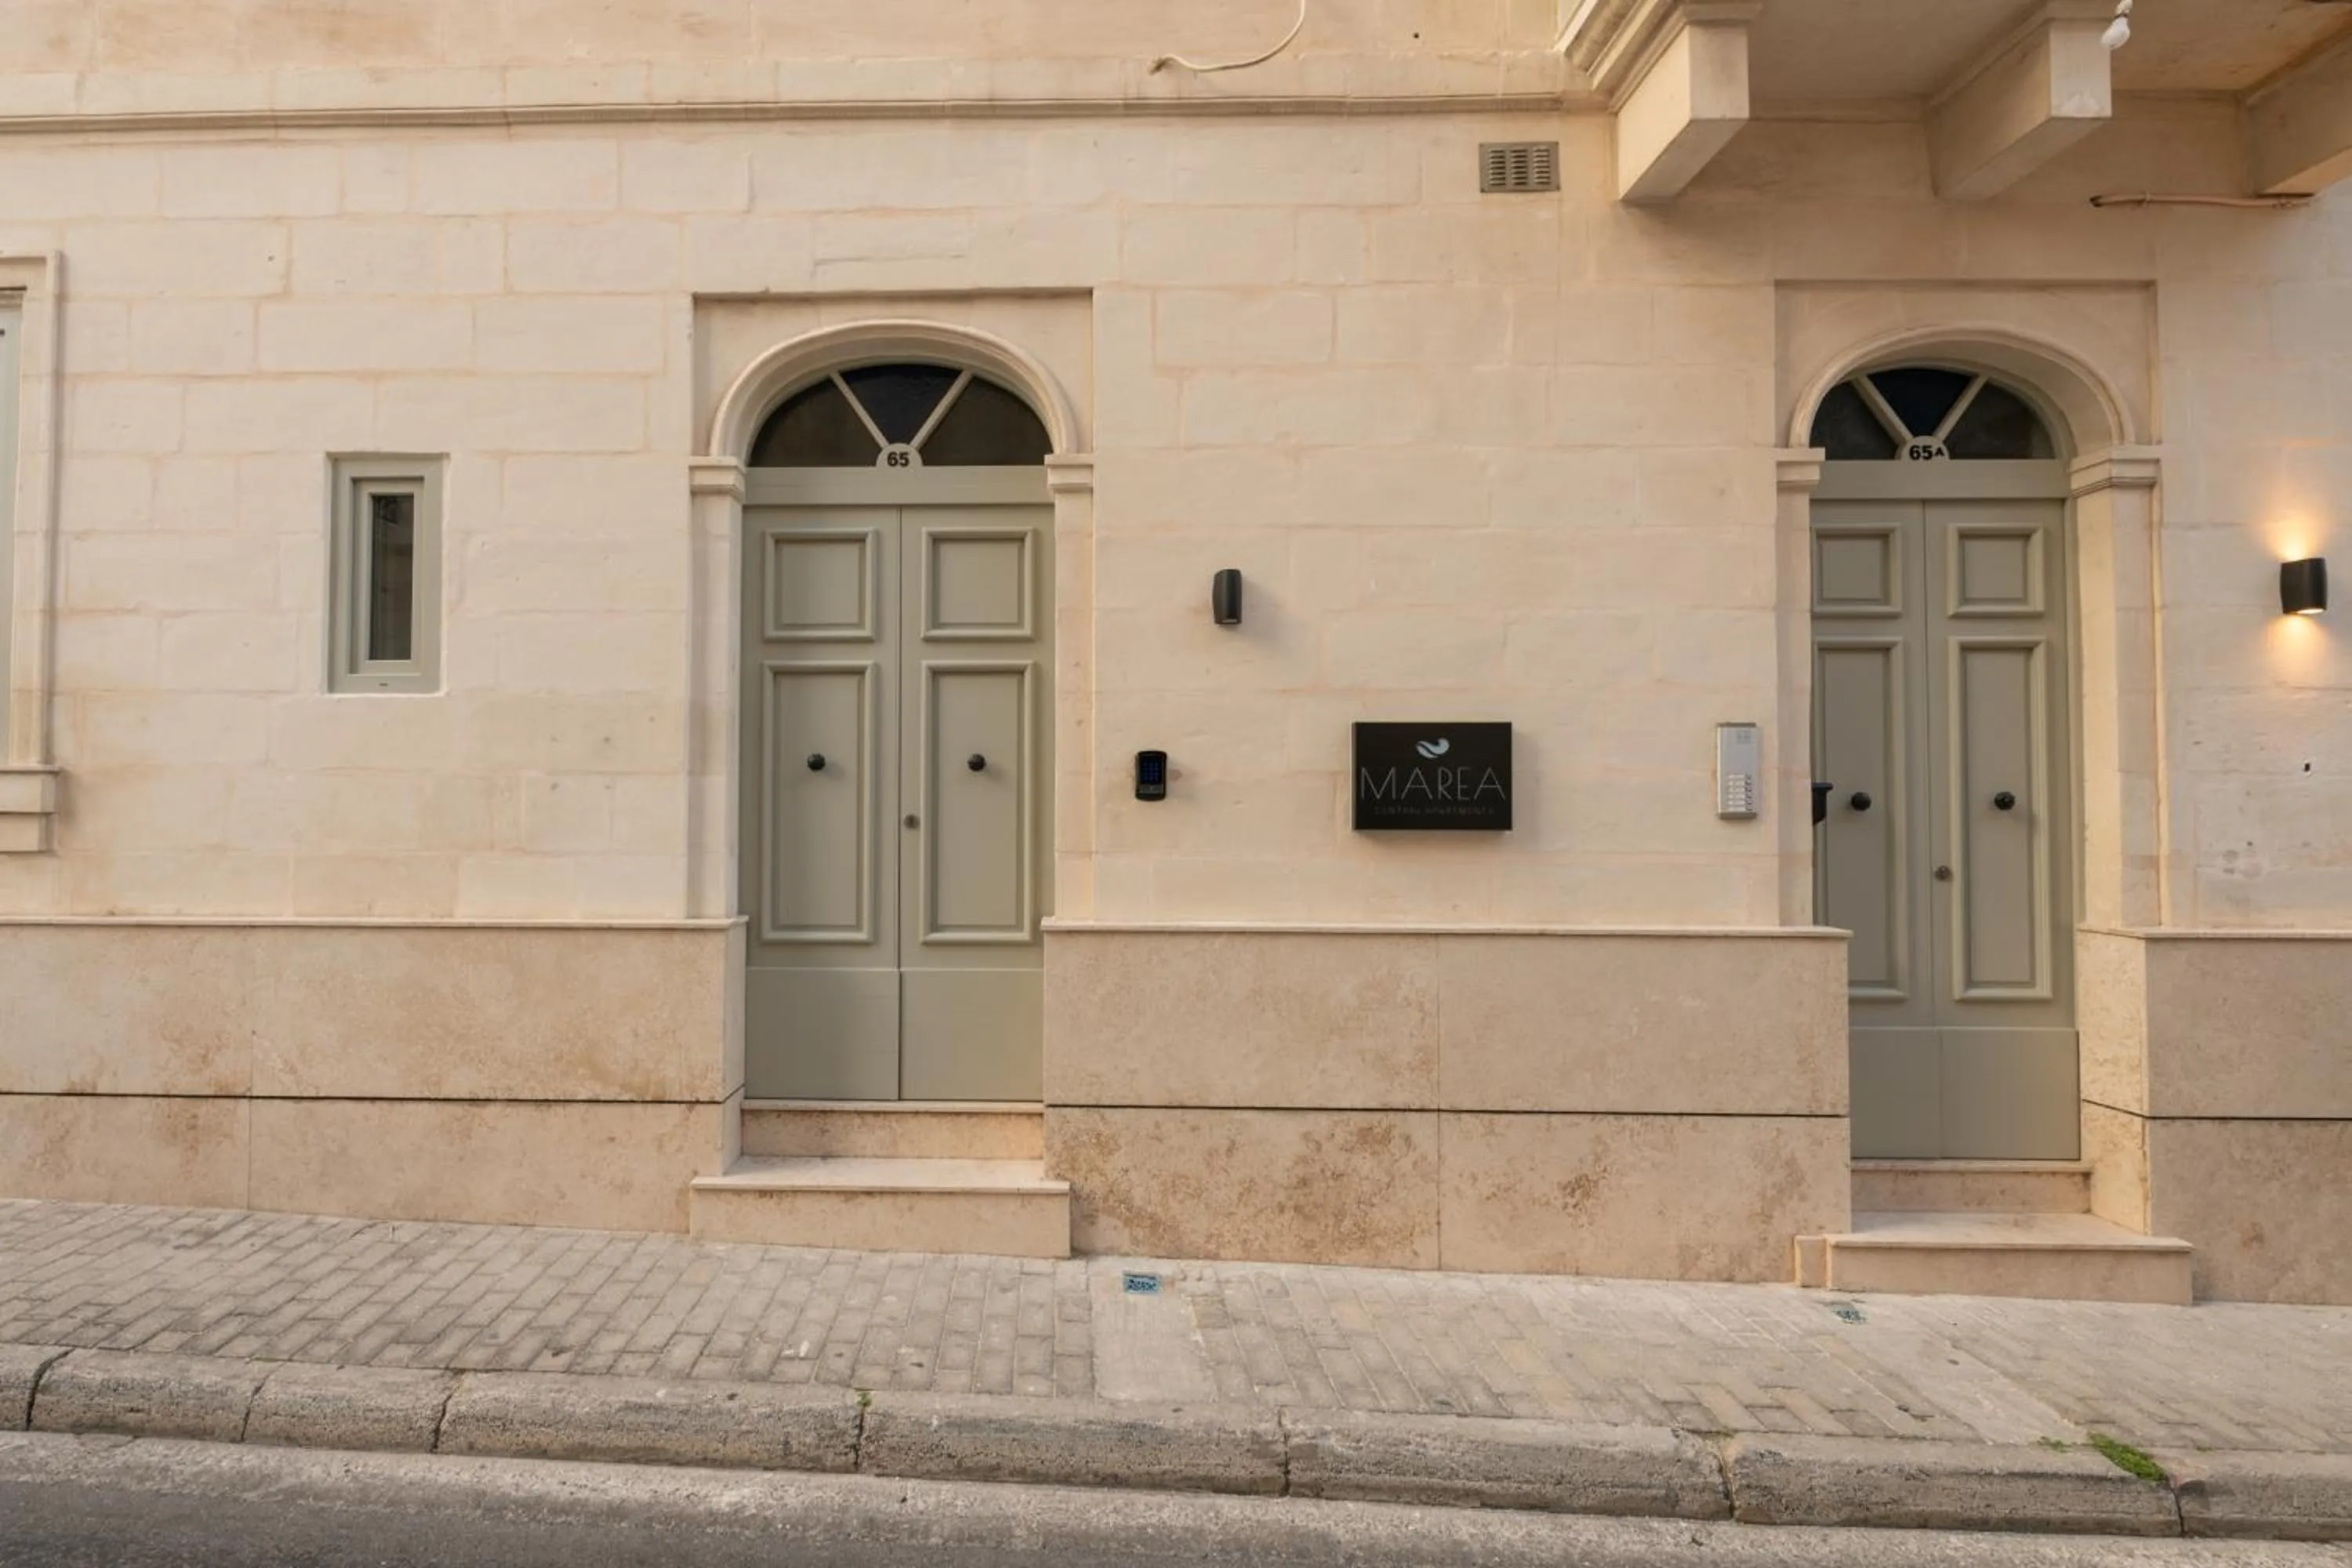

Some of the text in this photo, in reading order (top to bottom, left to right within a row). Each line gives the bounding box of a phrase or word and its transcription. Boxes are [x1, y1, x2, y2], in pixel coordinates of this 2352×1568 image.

[887, 451, 909, 467] 65
[1909, 445, 1945, 461] 65A
[1360, 766, 1506, 800] MAREA
